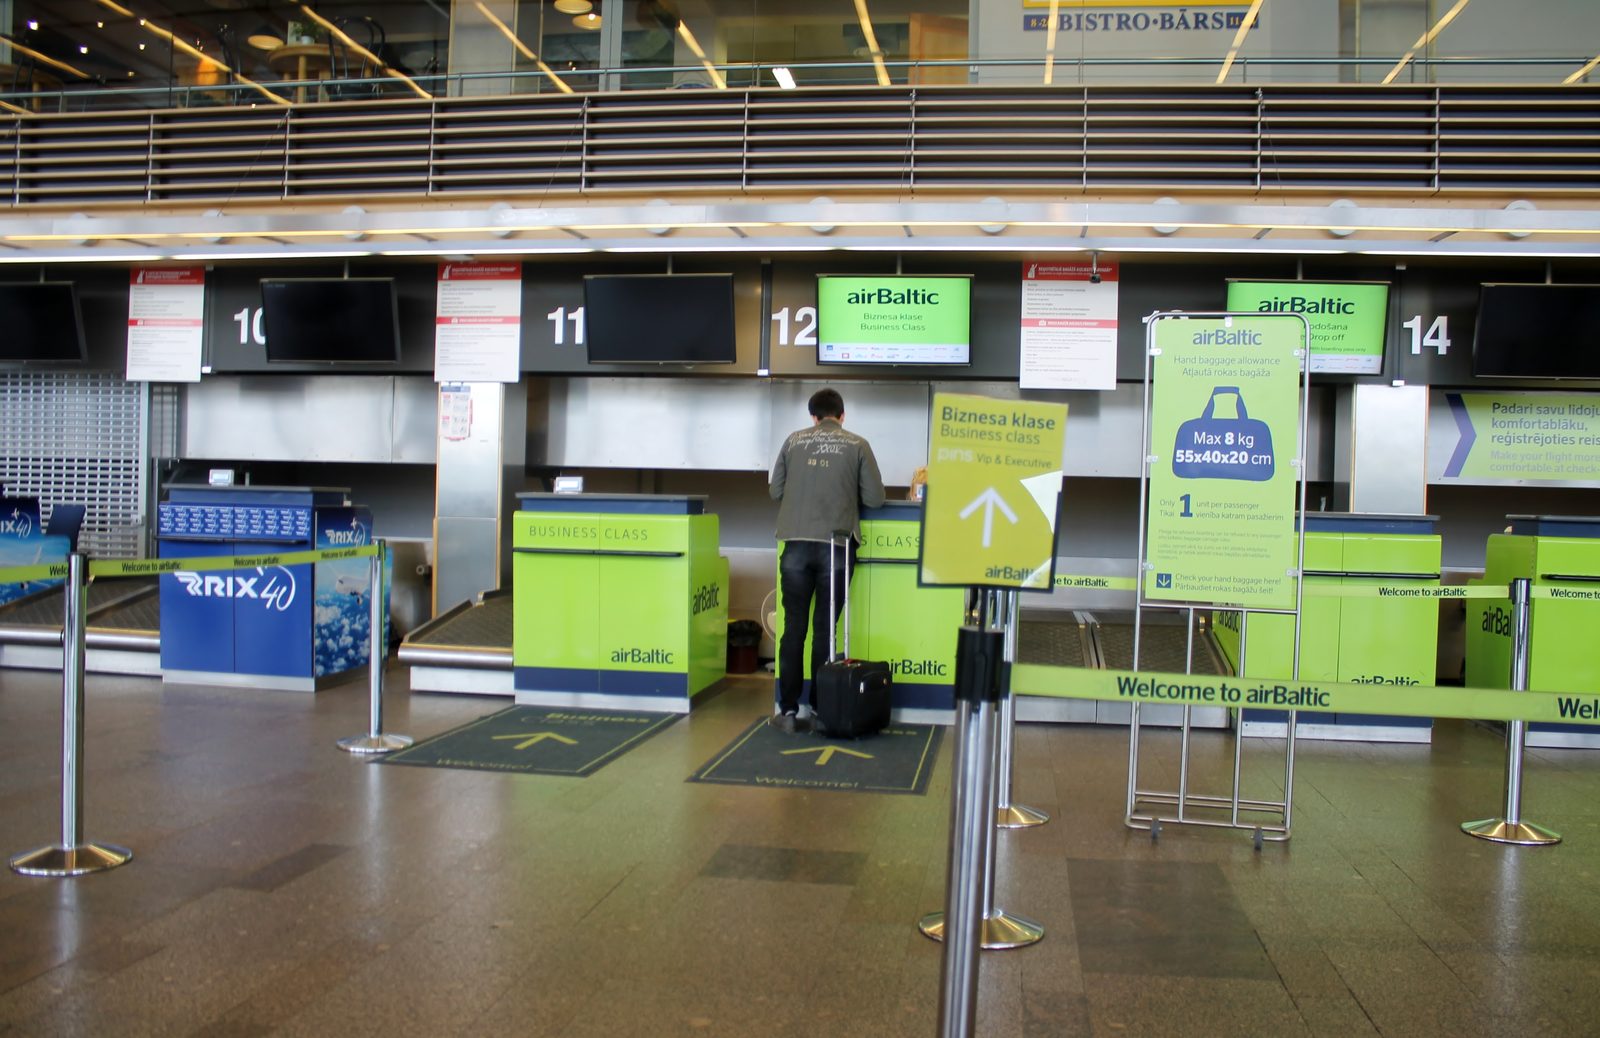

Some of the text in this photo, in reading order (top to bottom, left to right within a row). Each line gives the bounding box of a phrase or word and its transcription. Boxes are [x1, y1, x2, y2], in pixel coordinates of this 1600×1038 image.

[847, 288, 940, 305] airBaltic
[1258, 297, 1355, 315] airBaltic
[863, 313, 923, 321] Biznesa klase
[233, 306, 266, 346] 10
[547, 306, 584, 345] 11
[771, 306, 817, 346] 12
[860, 323, 926, 331] Business Class
[1303, 322, 1348, 330] odošana
[1192, 329, 1263, 346] airBaltic
[1331, 333, 1345, 341] off
[1402, 315, 1452, 356] 14
[1174, 356, 1281, 366] Hand baggage allowance
[1214, 368, 1238, 377] rokas
[1240, 369, 1271, 378] bagāža
[1491, 402, 1534, 415] Padari
[1536, 405, 1565, 416] savu
[942, 406, 1056, 431] Biznesa klase
[1491, 417, 1589, 432] komfortablāku,
[940, 423, 1040, 445] Business class
[1193, 431, 1255, 449] Max 8 kg
[1491, 432, 1576, 448] reģistrējoties
[977, 453, 992, 465] Vip
[994, 455, 1002, 465] &
[1004, 455, 1052, 469] Executive
[1175, 449, 1272, 465] 55x40x20 cm
[1490, 450, 1600, 463] Make your flight more
[1490, 463, 1552, 473] comfortable
[1554, 463, 1564, 473] at
[1159, 493, 1260, 518] Only 1 unit per passenger
[1160, 509, 1285, 522] Tikai vienība katram pasažierim
[529, 525, 648, 541] BUSINESS CLASS
[121, 563, 150, 573] Welcome
[151, 562, 158, 571] to
[204, 575, 259, 599] RIX
[1063, 578, 1073, 586] to
[1074, 578, 1109, 587] airBaltic
[1175, 573, 1197, 582] Check
[1197, 575, 1214, 583] your
[1214, 575, 1232, 584] hand
[1232, 576, 1263, 585] baggage
[1212, 585, 1232, 593] rokas
[1378, 587, 1467, 597] Welcome to airBaltic
[1550, 588, 1593, 599] Welcome
[692, 583, 720, 616] airBaltic
[611, 648, 674, 664] airBaltic
[890, 659, 947, 676] irBaltic
[1116, 676, 1330, 707] Welcome to airBaltic
[1557, 697, 1600, 719] Wel
[755, 776, 860, 788] Welcome!
